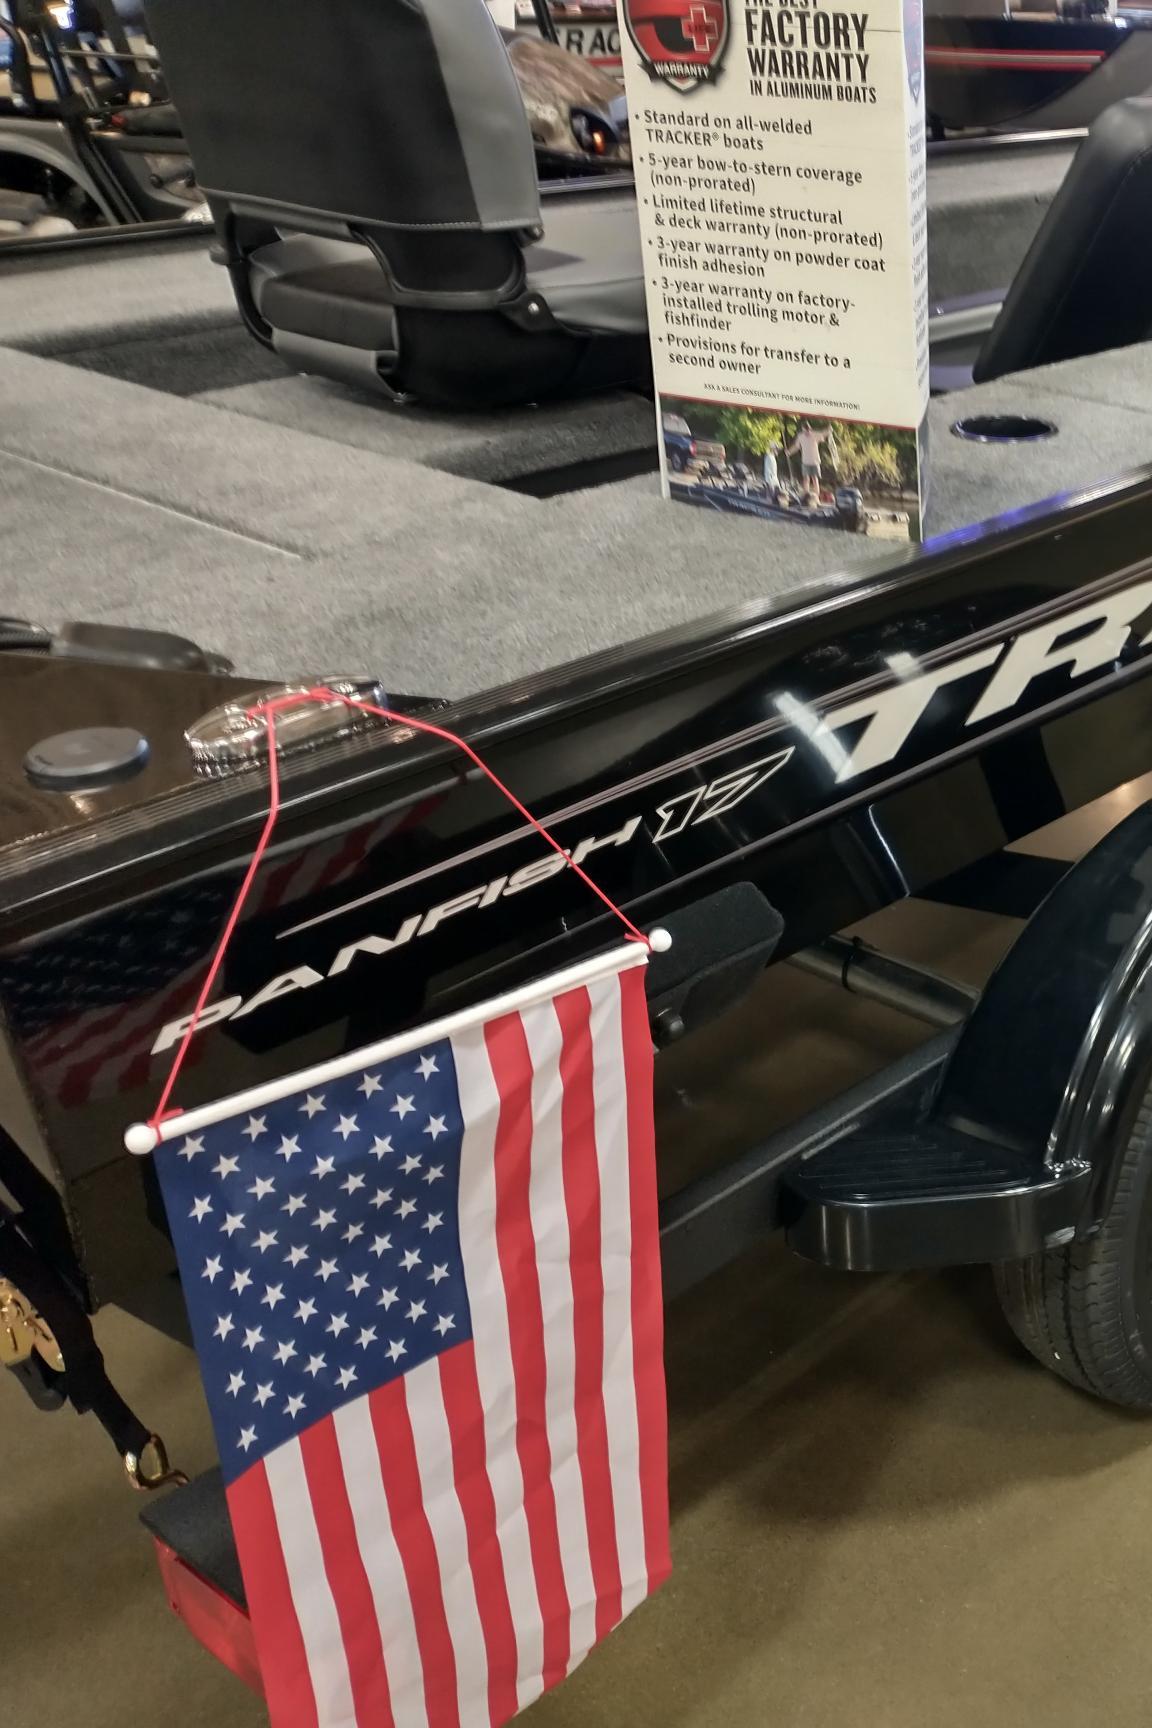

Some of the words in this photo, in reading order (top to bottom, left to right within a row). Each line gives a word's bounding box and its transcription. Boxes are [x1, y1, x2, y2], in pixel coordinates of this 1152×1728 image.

[744, 8, 869, 51] FACTORY
[653, 61, 709, 79] WARRANTY
[747, 48, 869, 83] WARRANTY
[750, 80, 763, 97] IN
[767, 80, 833, 101] ALUMINUM
[837, 85, 877, 104] BOATS
[644, 110, 709, 127] Standard
[714, 117, 731, 129] on
[736, 115, 812, 135] all-welded
[724, 134, 764, 150] boats
[649, 153, 693, 170] 5-year
[697, 155, 791, 177] bow-to-stern
[796, 166, 862, 186] coverage
[650, 170, 756, 196] (non-prorated)
[653, 194, 706, 212] Limited
[710, 198, 765, 217] lifetime
[770, 205, 843, 225] structural
[655, 213, 665, 226] &
[668, 214, 702, 230] deck
[705, 219, 770, 239] warranty
[776, 223, 882, 250] (non-prorated)
[657, 236, 701, 254] 3-year
[704, 242, 769, 263] warranty
[774, 250, 791, 262] on
[796, 252, 850, 268] powder
[854, 258, 886, 272] coat
[658, 253, 698, 270] finish
[702, 259, 764, 277] adhesion
[662, 276, 704, 293] 3-year
[709, 283, 772, 304] warranty
[776, 291, 794, 303] on
[798, 290, 855, 312] factory-
[663, 293, 722, 312] installed
[727, 302, 778, 323] trolling
[782, 310, 825, 324] motor
[830, 313, 840, 326] &
[664, 311, 732, 331] fishfinder
[667, 333, 736, 354] Provisions
[740, 342, 760, 357] for
[764, 346, 820, 364] transfer
[824, 354, 838, 367] to
[844, 358, 850, 368] a
[668, 352, 714, 368] second
[719, 360, 761, 374] owner
[704, 383, 716, 391] ASK
[722, 386, 740, 394] SALES
[742, 389, 780, 400] CONSULTANT
[782, 394, 794, 402] FOR
[795, 396, 812, 404] MORE
[150, 815, 642, 1055] PANFISH
[652, 745, 796, 843] 17
